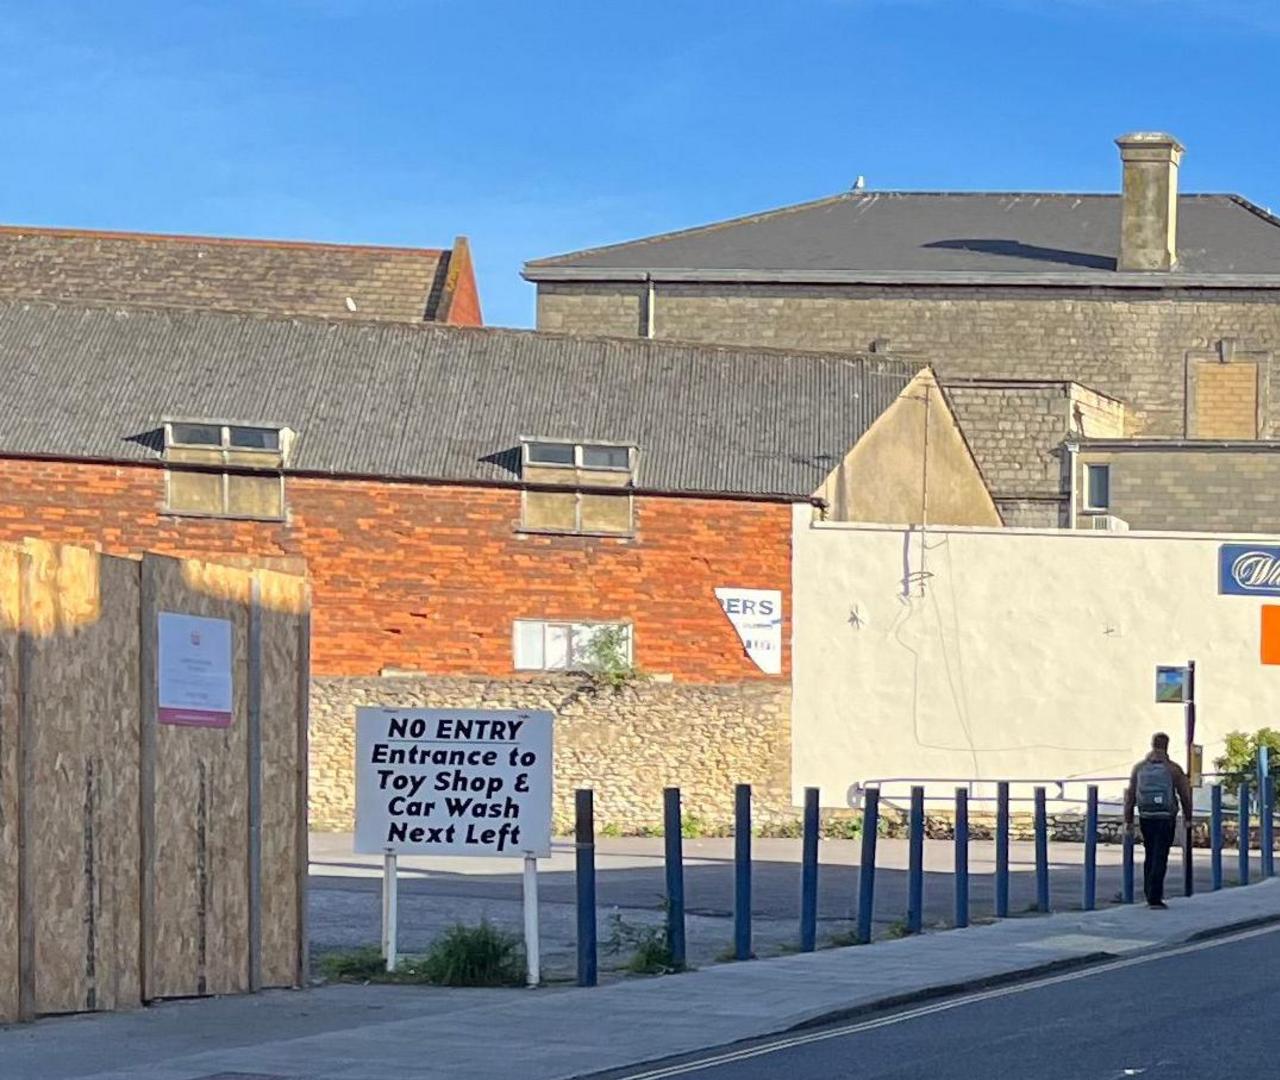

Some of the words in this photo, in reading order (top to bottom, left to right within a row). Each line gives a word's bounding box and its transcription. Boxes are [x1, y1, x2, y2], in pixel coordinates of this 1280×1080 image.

[388, 718, 427, 739] NO
[436, 719, 524, 740] ENTRY
[371, 744, 498, 766] Entrance
[509, 747, 536, 767] to
[377, 770, 427, 797] Toy
[434, 770, 503, 799] Shop
[514, 773, 529, 793] &
[388, 796, 436, 817] Car
[445, 797, 520, 819] Wash
[387, 822, 456, 843] Next
[465, 823, 521, 851] Left
